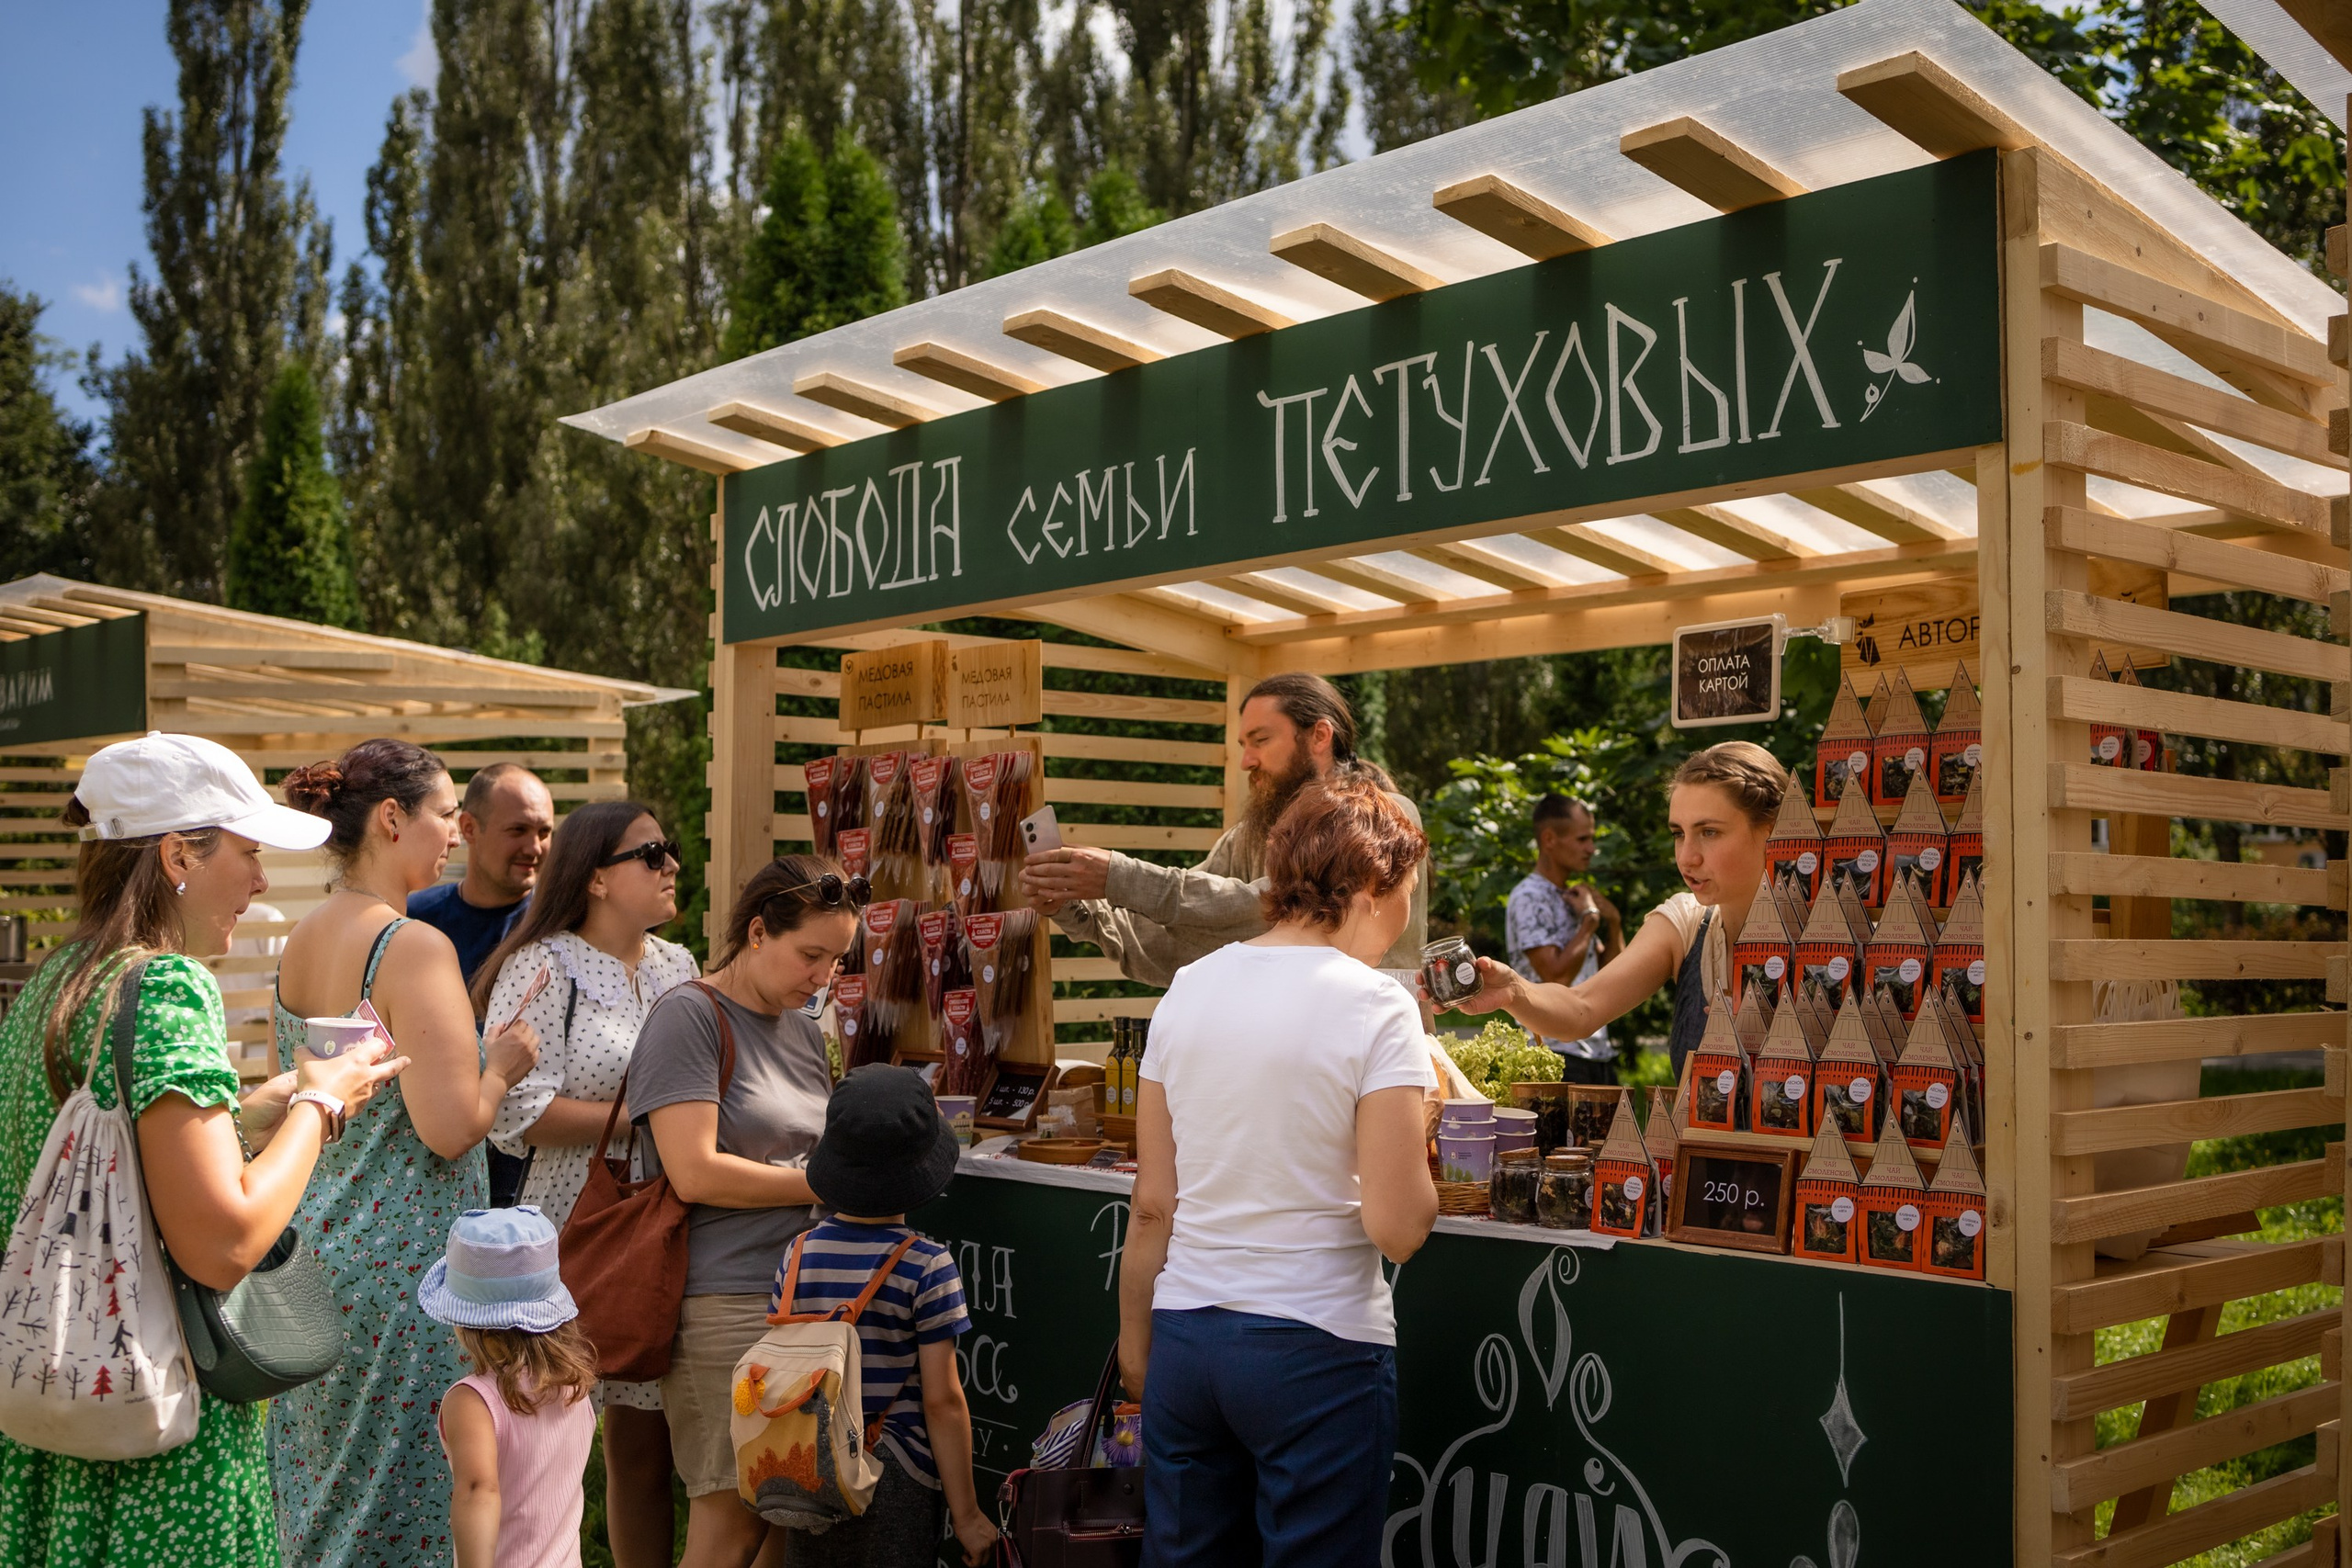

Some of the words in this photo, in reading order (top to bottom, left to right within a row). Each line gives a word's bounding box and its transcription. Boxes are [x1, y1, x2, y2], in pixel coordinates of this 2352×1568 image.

[744, 456, 962, 612] СЛОБОДА
[1007, 447, 1199, 565] СЕМЬИ
[1256, 258, 1843, 524] ПЕТУХОВЫХ
[858, 661, 913, 684] МЕДОВАЯ
[1698, 654, 1750, 673] ОПЛАТА
[961, 667, 1012, 685] МЕДОВАЯ
[1700, 671, 1748, 694] КАРТОЙ
[858, 691, 911, 712] ПАСТИЛА
[961, 693, 1011, 709] ПАСТИЛА
[1017, 1086, 1029, 1094] 130
[1807, 1168, 1852, 1178] СМОЛЕНСКИЙ
[1869, 1174, 1917, 1183] СМОЛЕНСКИЙ
[1951, 1171, 1965, 1179] ЧАЙ
[1935, 1179, 1980, 1189] СМОЛЕНСКИЙ
[1702, 1181, 1739, 1204] 250
[1745, 1188, 1765, 1210] р.
